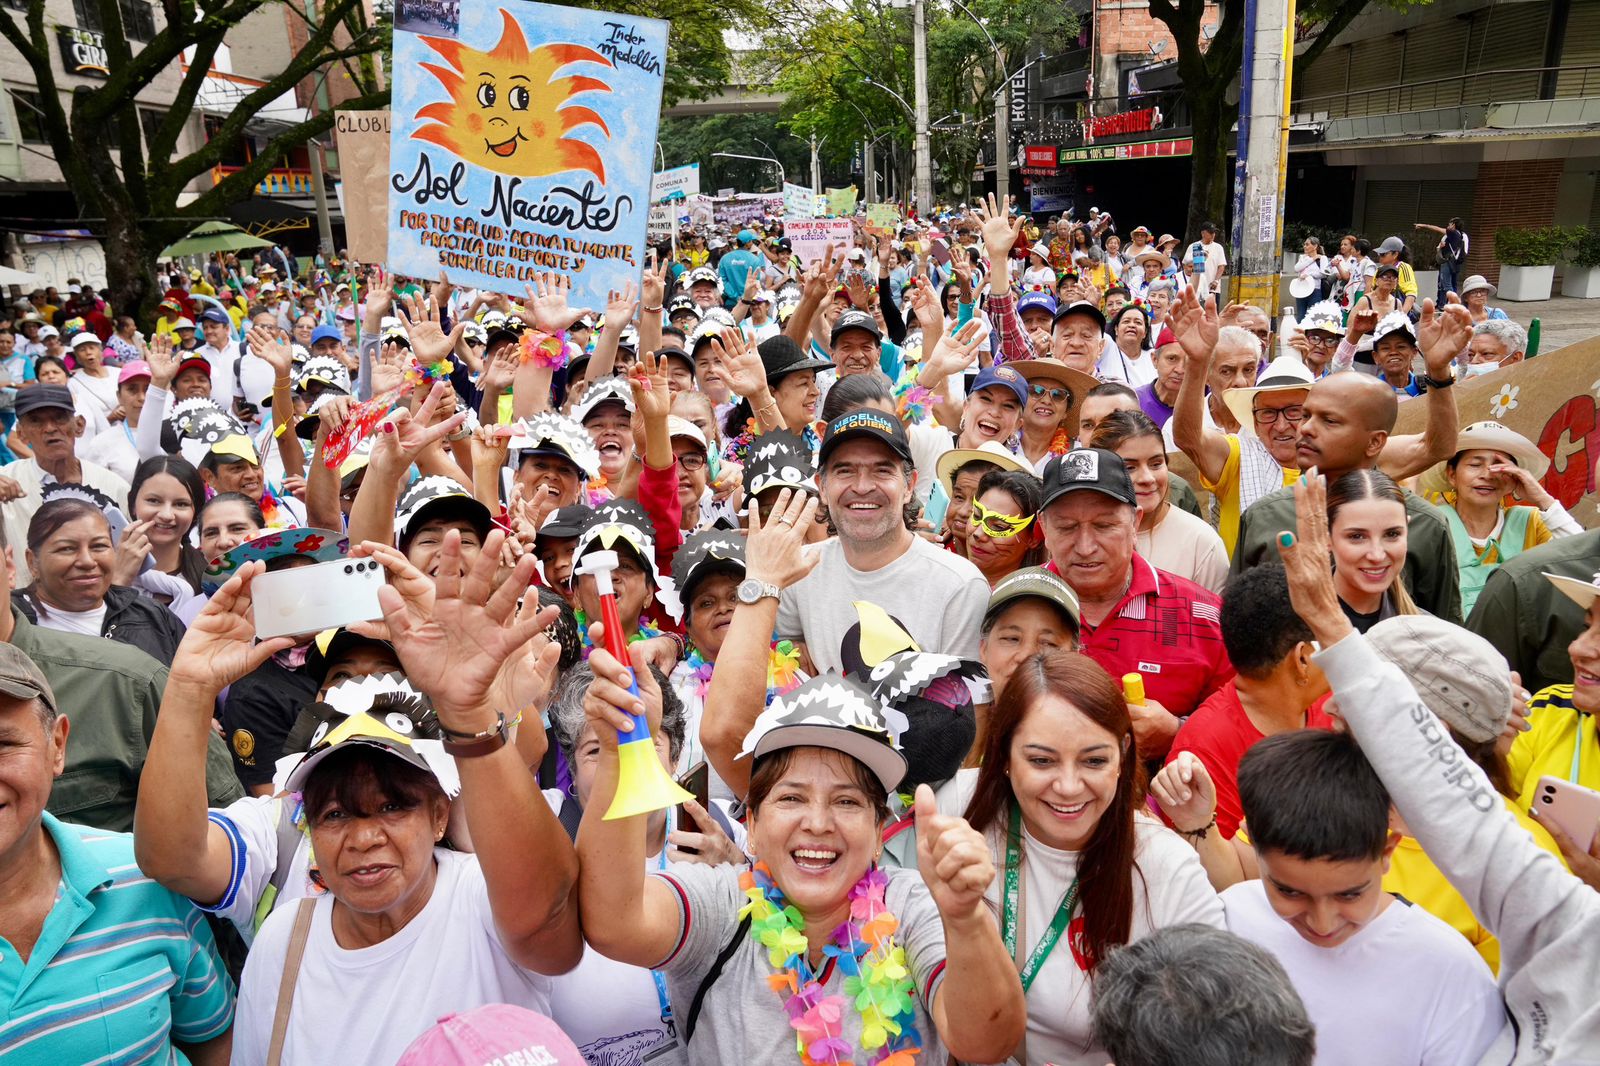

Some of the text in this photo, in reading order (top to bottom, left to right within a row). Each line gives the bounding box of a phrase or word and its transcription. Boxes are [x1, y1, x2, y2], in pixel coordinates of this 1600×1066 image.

[603, 22, 645, 45] Inder
[1011, 70, 1025, 121] HOTEL
[392, 152, 468, 205] Sol
[656, 178, 683, 189] COMUNA
[650, 211, 666, 220] VIDA
[400, 210, 428, 230] POR
[431, 214, 451, 233] TU
[510, 229, 562, 250] ACTIVA
[563, 237, 582, 253] TU
[487, 242, 505, 257] UN
[510, 246, 569, 271] DEPORTE
[518, 265, 537, 282] LA
[834, 419, 893, 435] TE QUIERE
[1410, 703, 1495, 813] adidas
